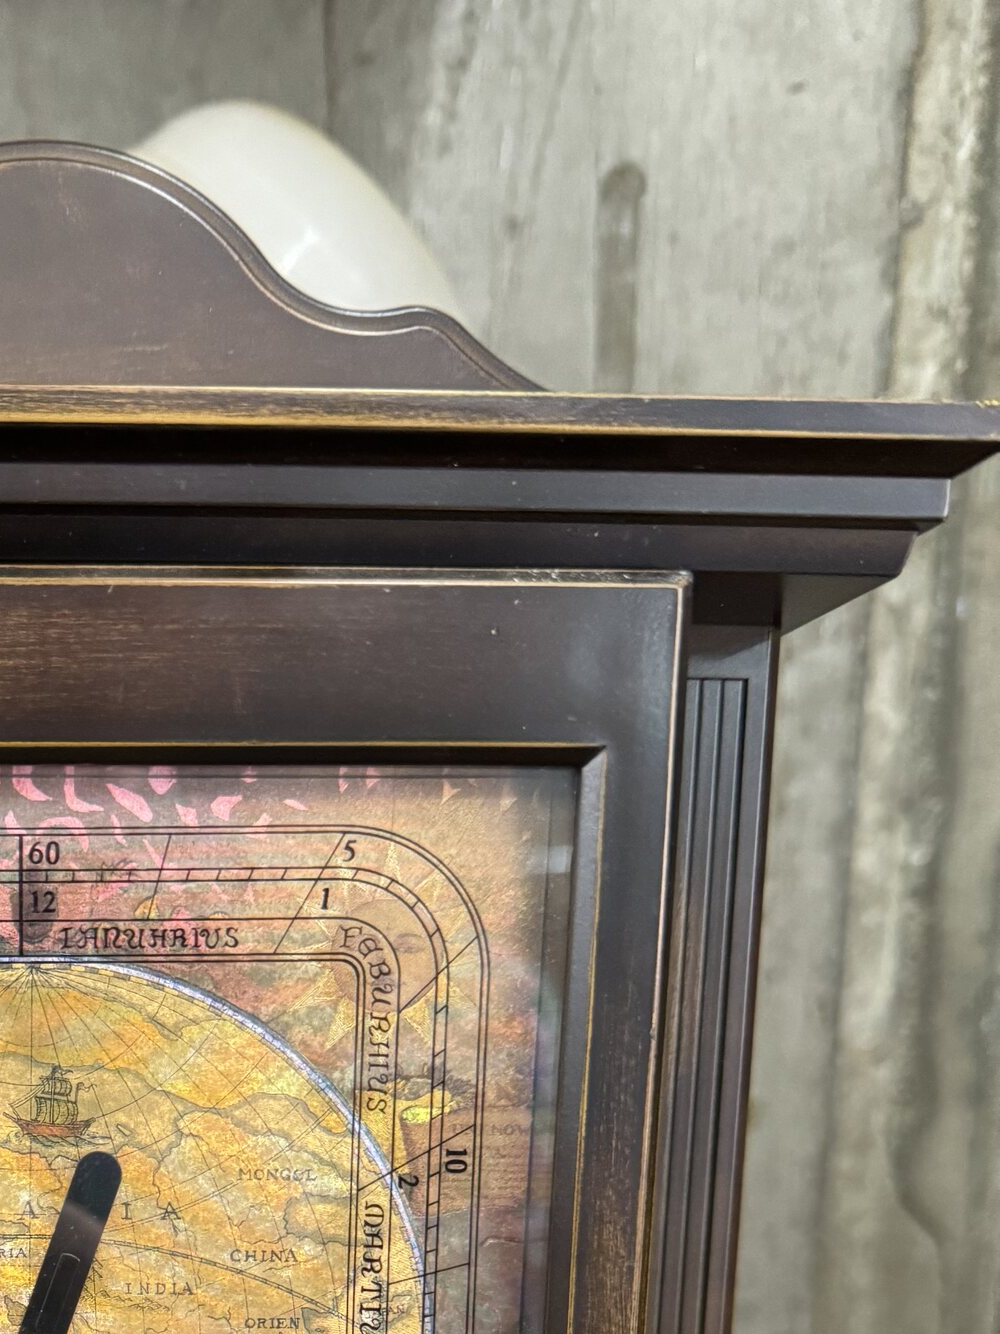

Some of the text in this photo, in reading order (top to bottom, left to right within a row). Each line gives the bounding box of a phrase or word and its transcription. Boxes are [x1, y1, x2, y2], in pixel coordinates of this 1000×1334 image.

[28, 841, 60, 865] 60
[342, 840, 357, 862] 5
[31, 891, 56, 914] 12
[321, 888, 331, 910] 1
[444, 1148, 468, 1174] 10
[397, 1174, 420, 1188] 2
[20, 1200, 181, 1220] AIA
[229, 1249, 299, 1263] CHINA
[124, 1282, 194, 1296] INDIA
[244, 1317, 300, 1330] ORIEN
